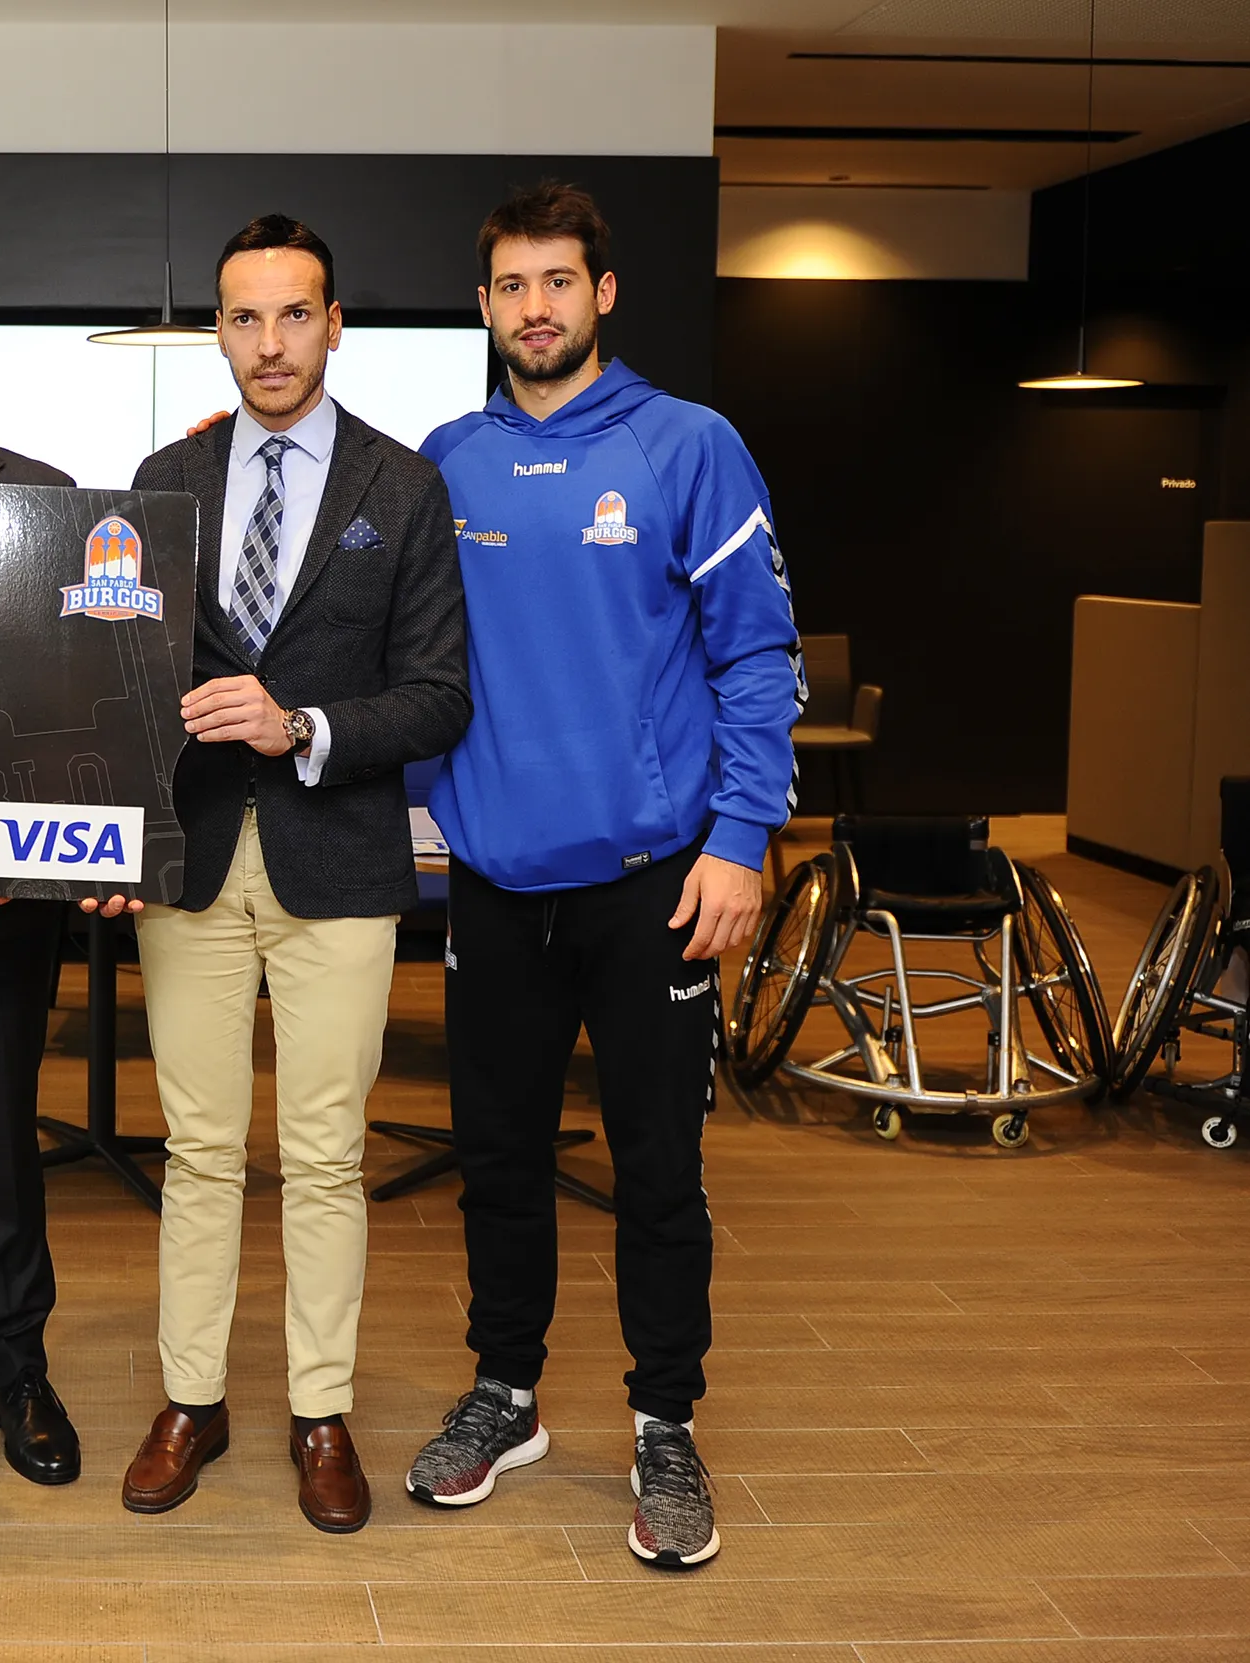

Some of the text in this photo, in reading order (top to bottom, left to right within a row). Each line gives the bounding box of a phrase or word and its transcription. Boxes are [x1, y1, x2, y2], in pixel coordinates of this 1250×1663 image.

[513, 458, 568, 478] hummel
[1161, 477, 1196, 489] Privado
[586, 527, 635, 541] BURGOS
[91, 579, 134, 589] SAN PABLO
[69, 587, 158, 613] BURGOS
[669, 974, 711, 1002] hummel
